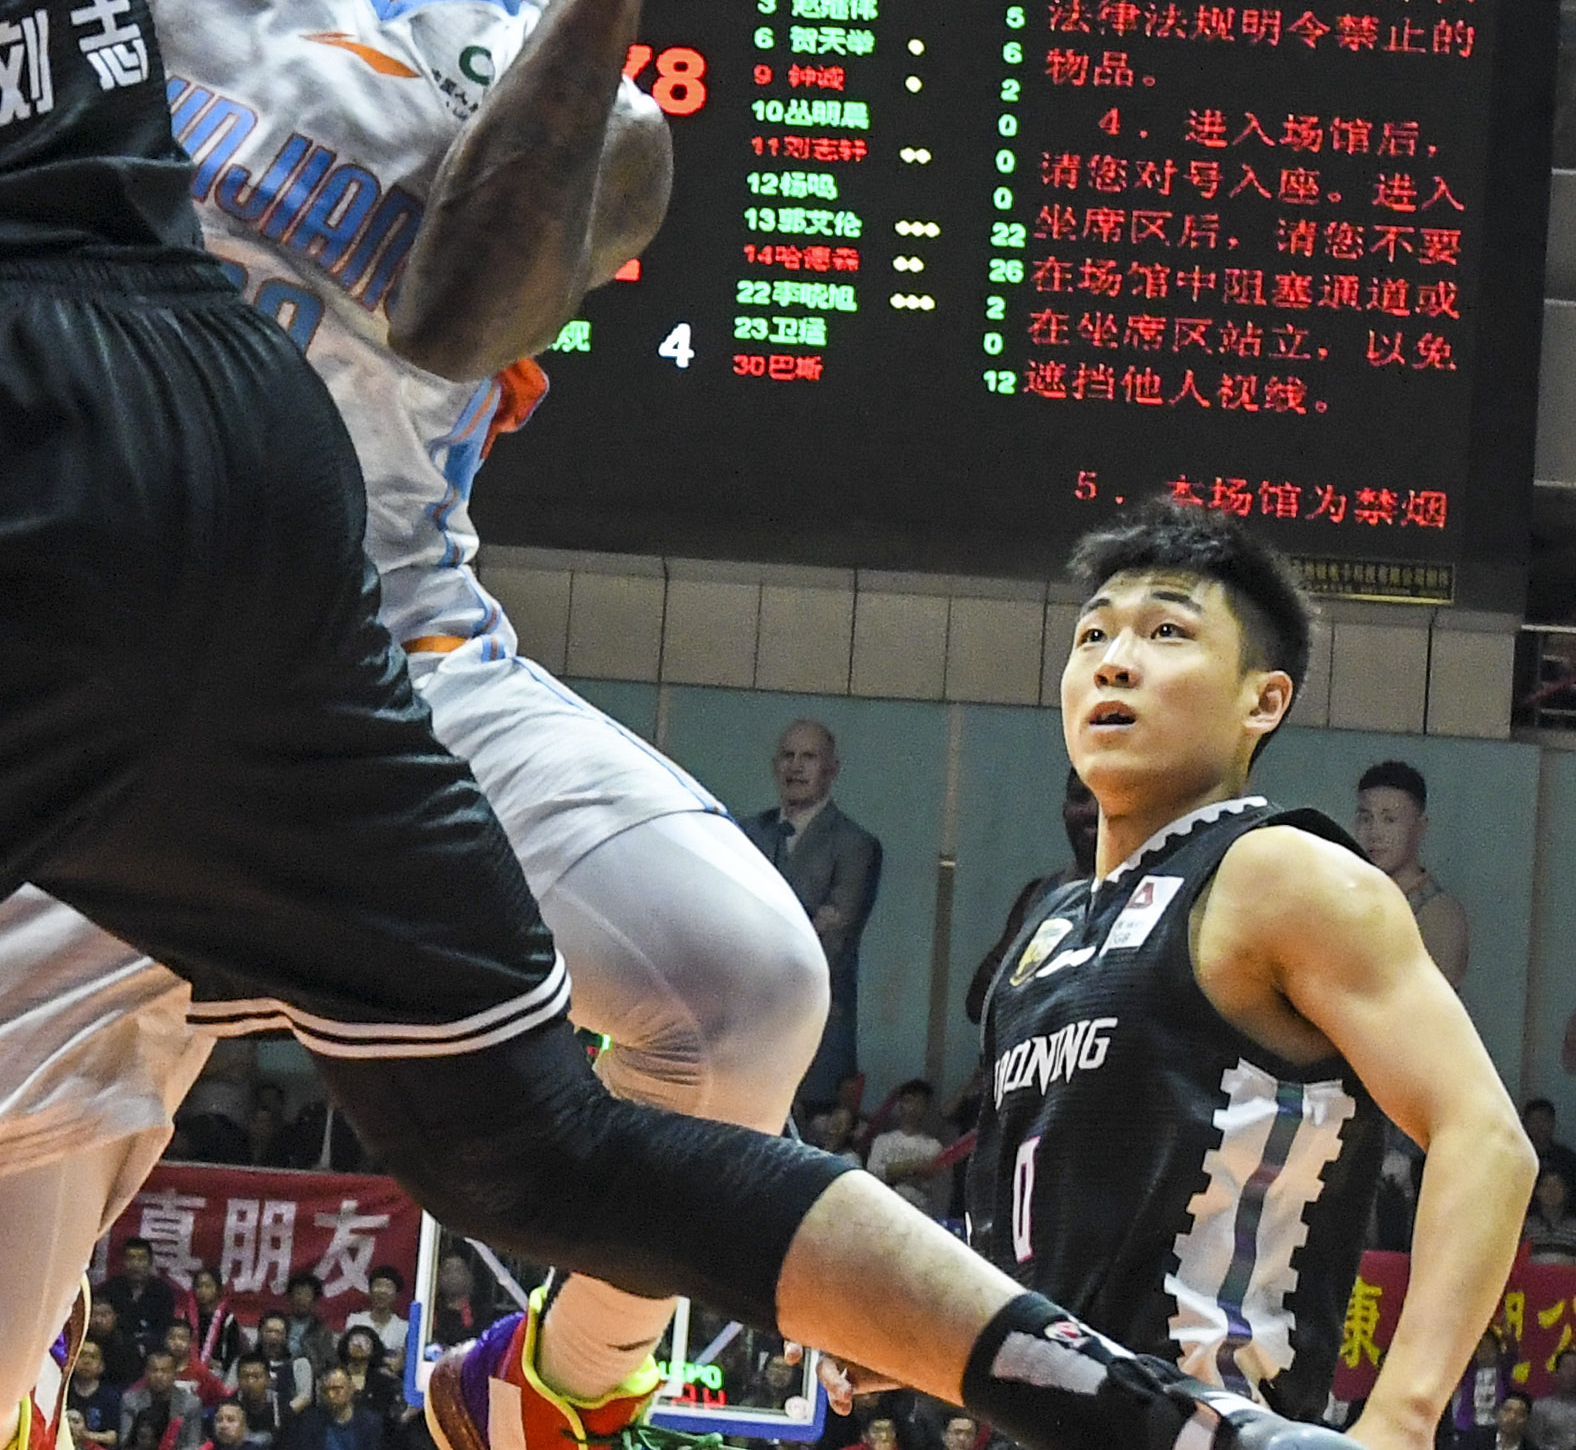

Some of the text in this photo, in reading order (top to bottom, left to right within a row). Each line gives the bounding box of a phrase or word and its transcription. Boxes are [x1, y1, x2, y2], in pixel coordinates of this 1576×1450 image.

[1006, 5, 1026, 30] 5
[753, 26, 775, 50] 6
[1002, 41, 1023, 65] 6
[753, 64, 772, 86] 9
[1000, 77, 1022, 103] 2
[997, 113, 1018, 138] 0
[995, 149, 1016, 174] 0
[993, 186, 1014, 211] 0
[989, 221, 1027, 249] 22
[989, 258, 1025, 284] 26
[1031, 255, 1461, 320] 在场馆中阻塞通道或
[986, 295, 1006, 321] 2
[658, 323, 695, 368] 4
[983, 331, 1004, 357] 0
[983, 369, 1017, 395] 12
